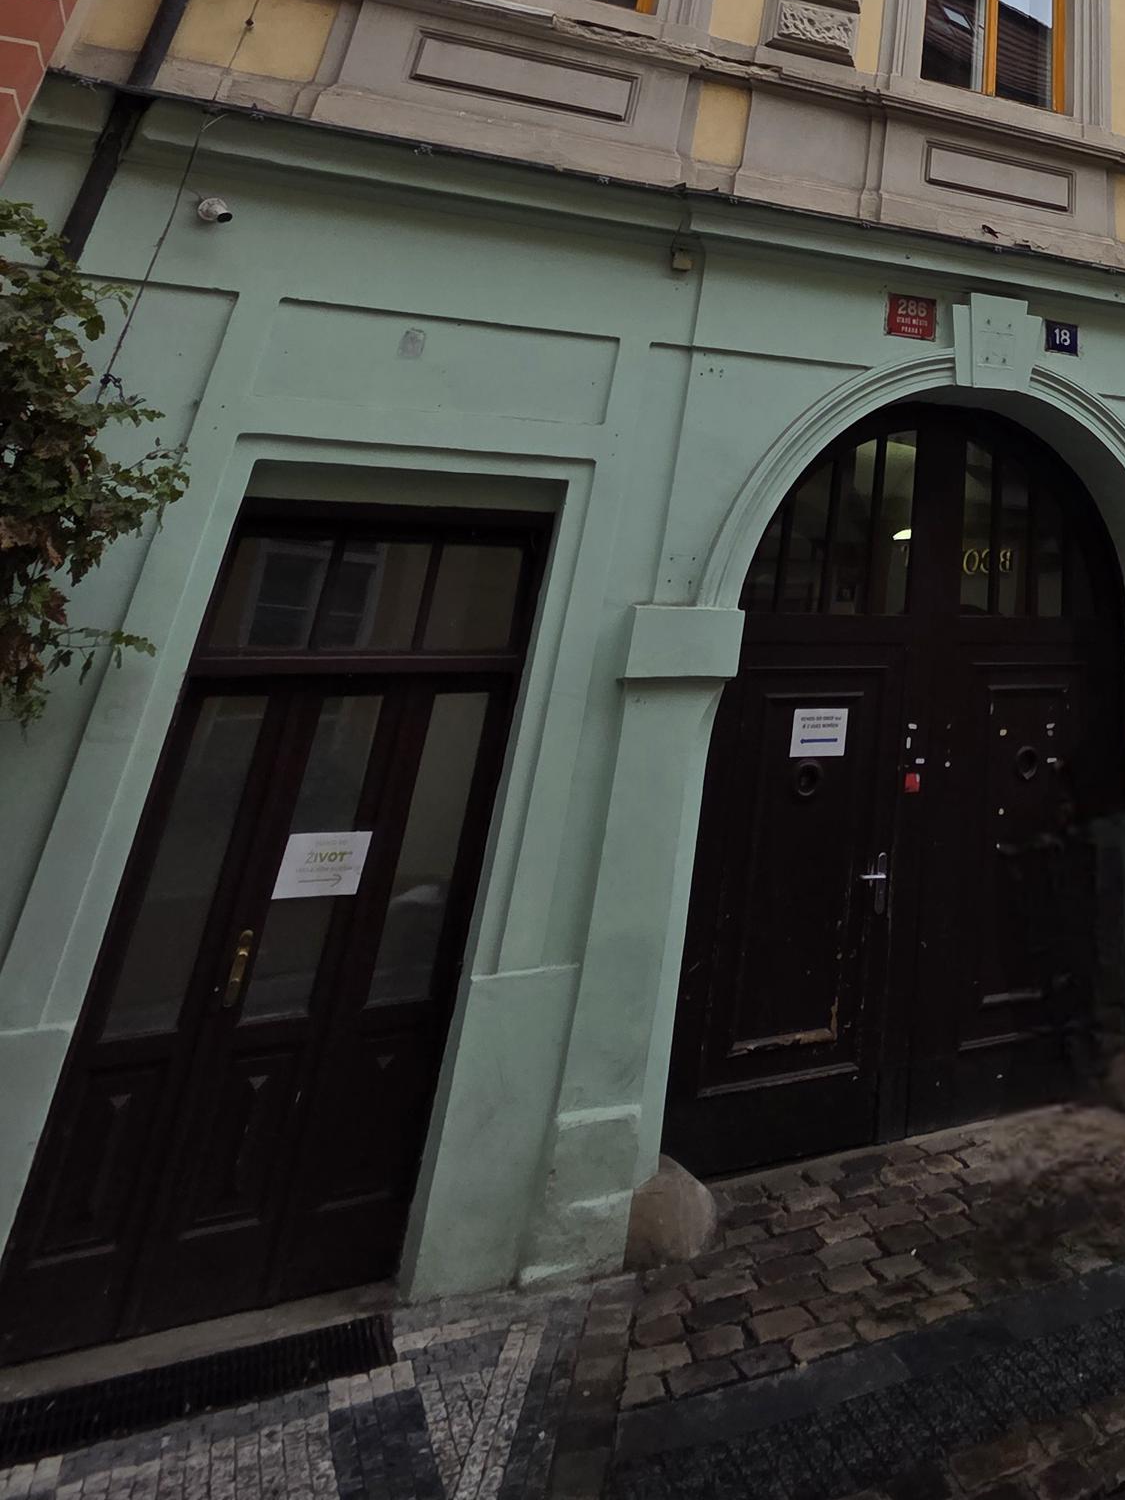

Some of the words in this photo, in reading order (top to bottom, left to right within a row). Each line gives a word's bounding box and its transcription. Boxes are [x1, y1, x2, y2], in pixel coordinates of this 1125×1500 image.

[897, 299, 927, 317] 286
[901, 326, 918, 334] PRAHA
[1054, 328, 1071, 346] 18
